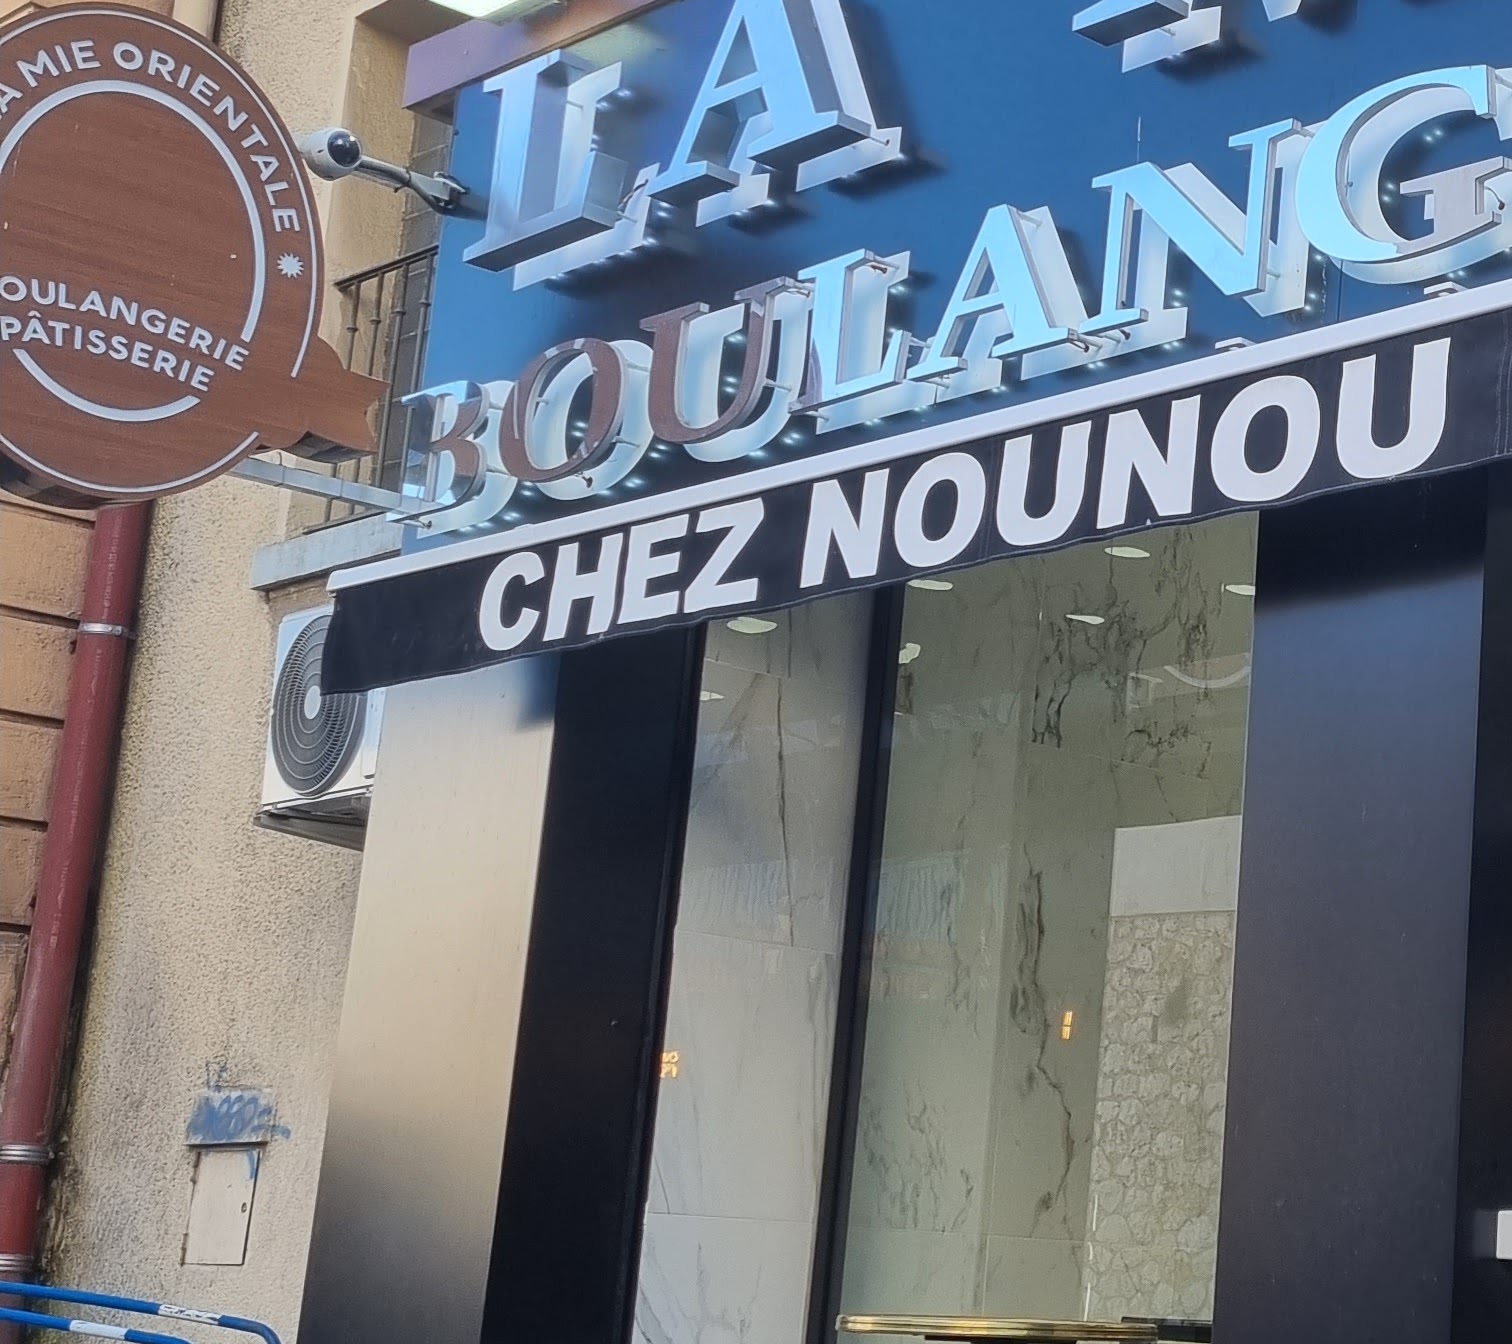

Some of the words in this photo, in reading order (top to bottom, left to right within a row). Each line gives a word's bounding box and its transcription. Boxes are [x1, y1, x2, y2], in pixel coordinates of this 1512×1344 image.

[16, 39, 102, 88] MIE
[113, 41, 301, 234] ORIENTALE
[0, 310, 215, 392] PÂTISSERIE
[479, 496, 766, 653] CHEZ
[800, 337, 1453, 588] NOUNOU
